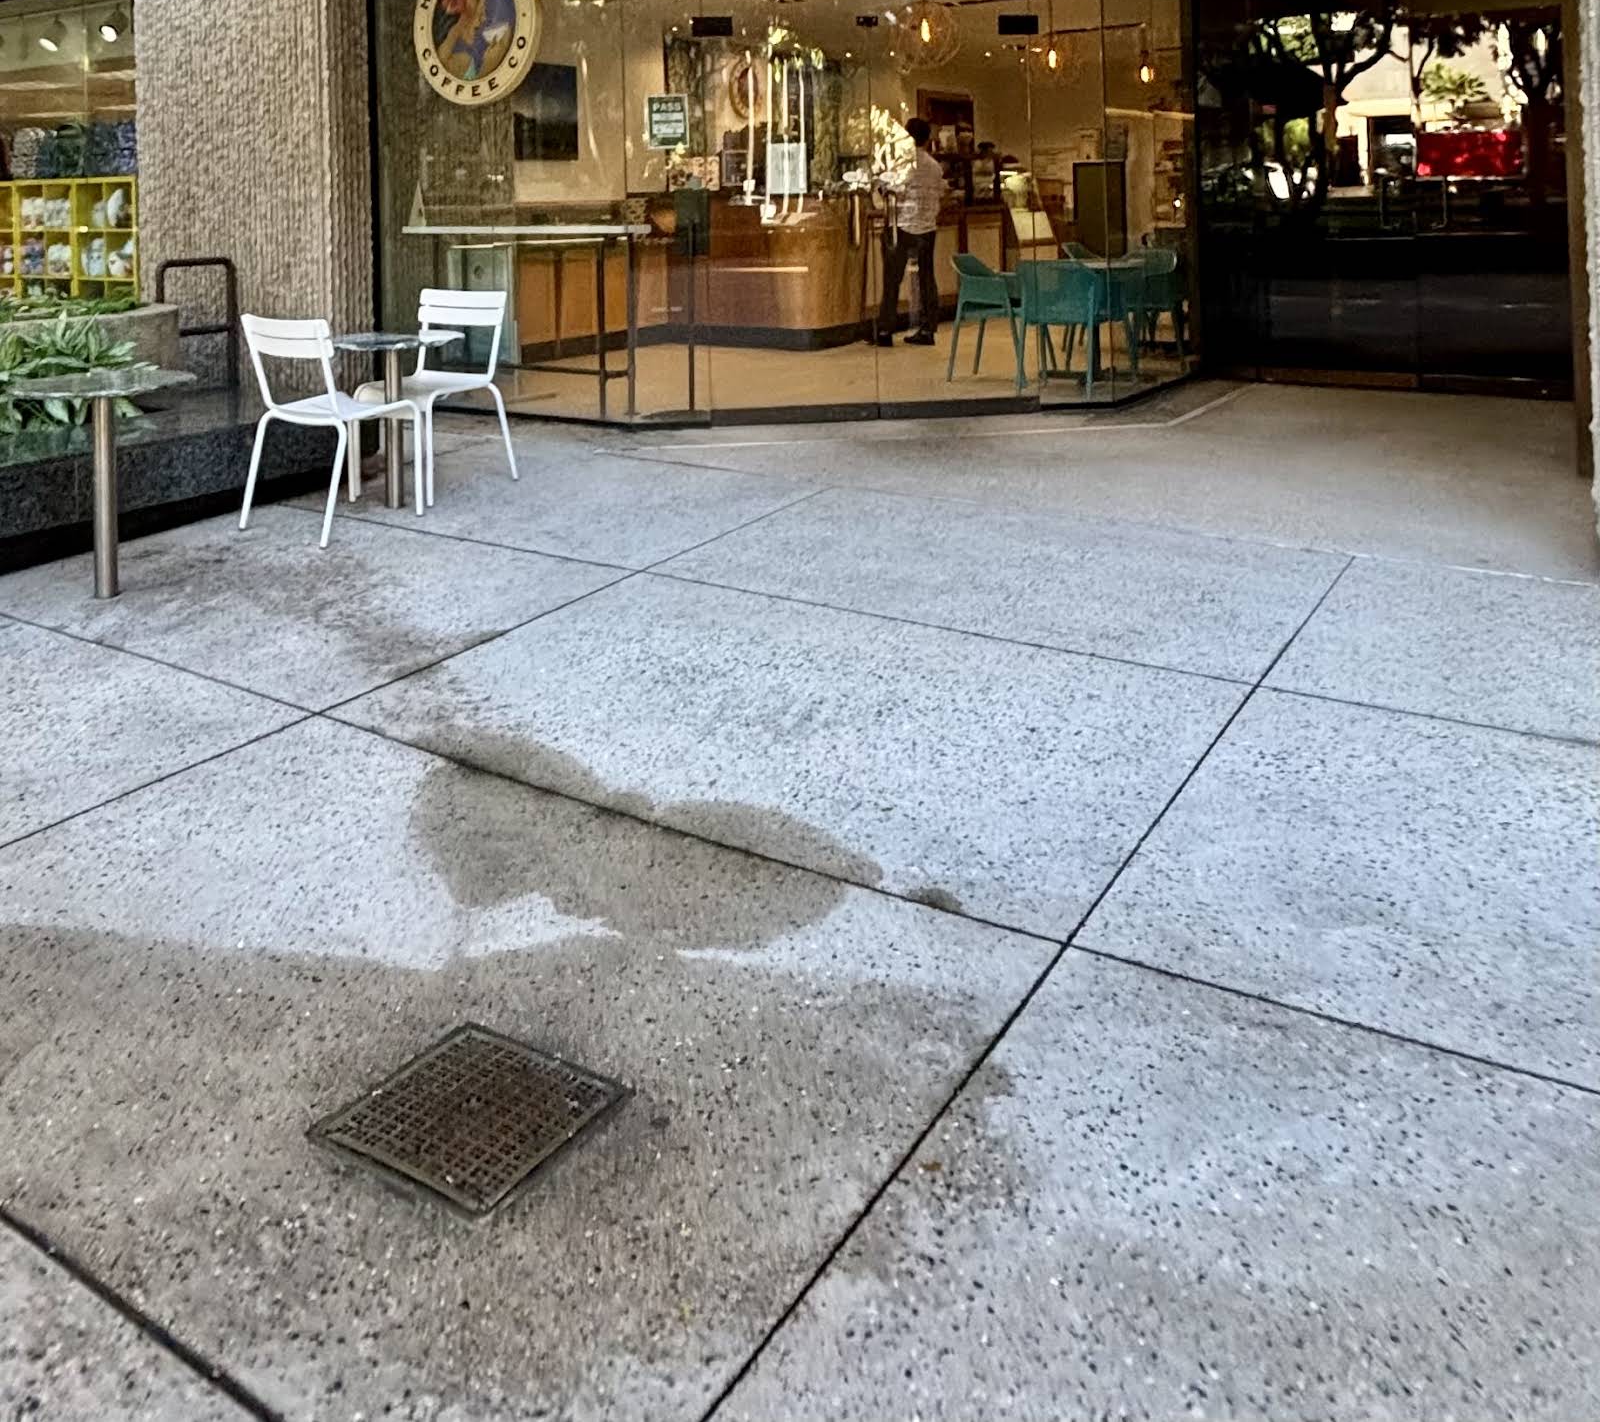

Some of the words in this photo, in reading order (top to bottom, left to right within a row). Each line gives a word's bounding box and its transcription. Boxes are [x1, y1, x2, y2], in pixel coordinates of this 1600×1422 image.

[422, 47, 499, 97] COFFEE
[508, 36, 527, 69] CO
[652, 102, 681, 112] PASS
